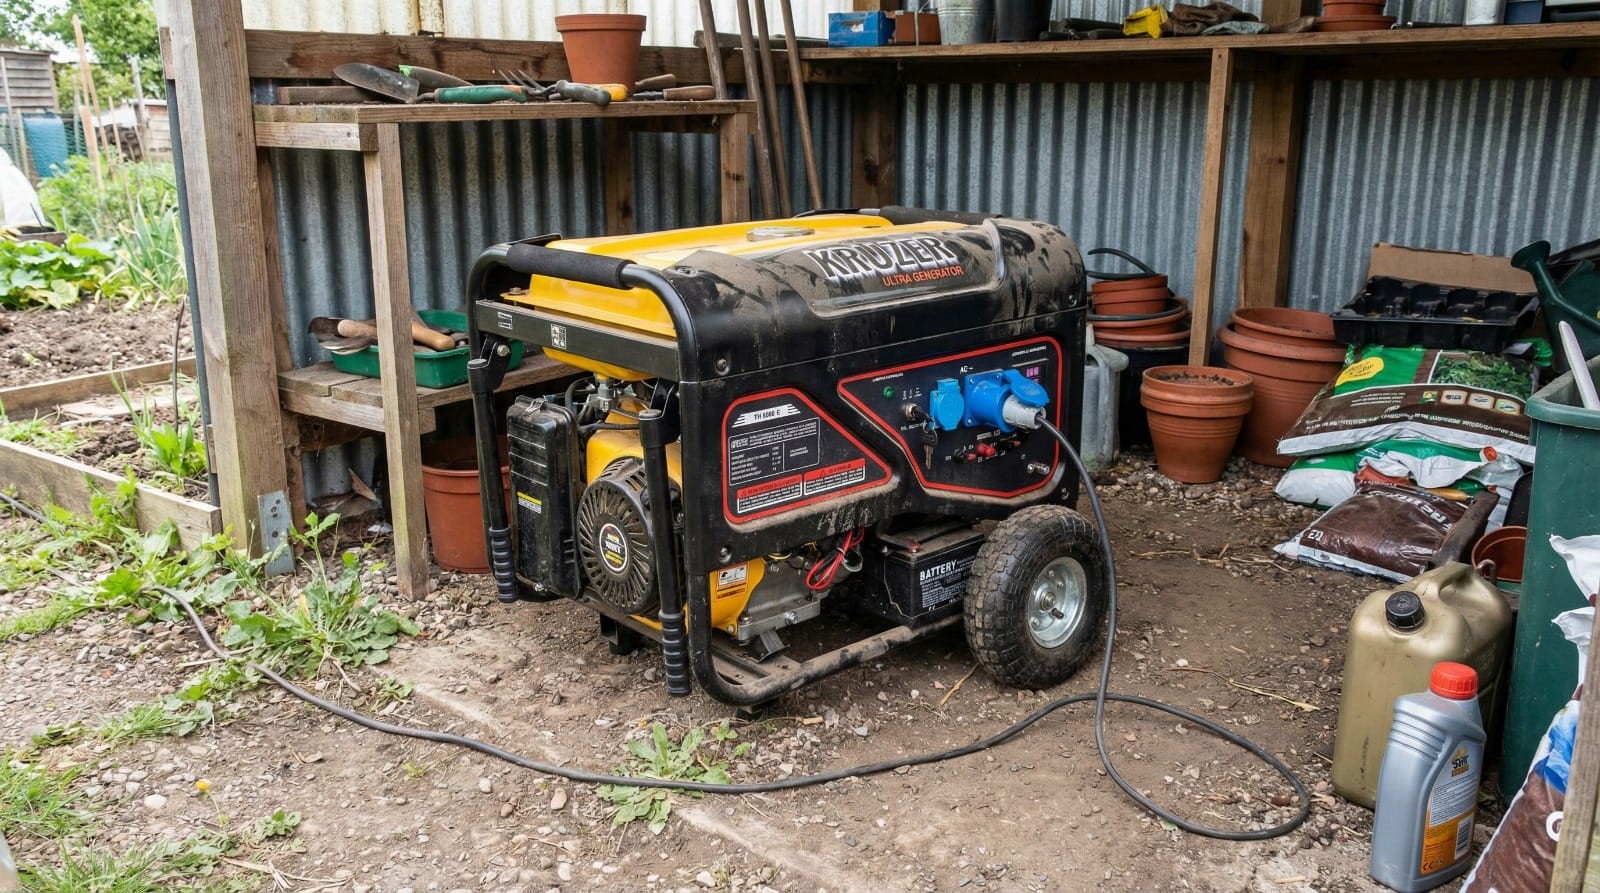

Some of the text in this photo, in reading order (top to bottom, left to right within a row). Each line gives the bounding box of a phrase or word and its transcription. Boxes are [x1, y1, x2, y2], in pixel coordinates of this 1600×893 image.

[803, 237, 960, 281] KRUZER
[882, 265, 965, 287] ULTRA GENERATOR
[920, 560, 956, 580] BATTERY
